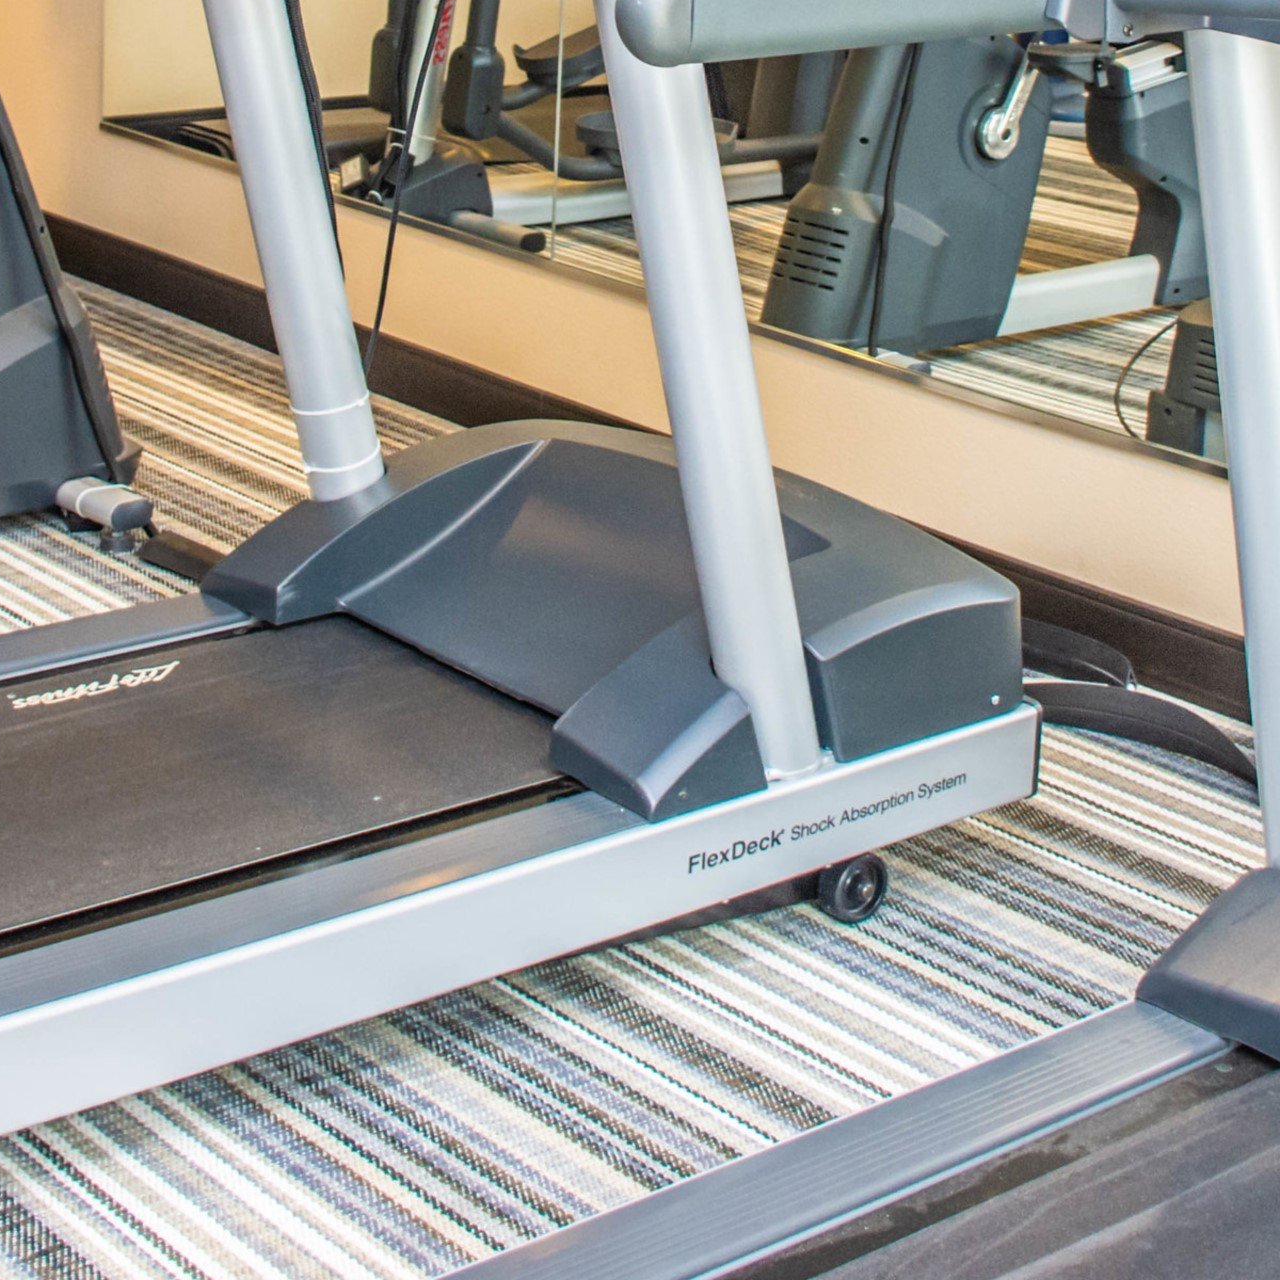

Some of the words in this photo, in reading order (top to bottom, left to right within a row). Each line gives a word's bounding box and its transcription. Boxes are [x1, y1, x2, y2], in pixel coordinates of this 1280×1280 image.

[688, 829, 782, 874] FlexDeck
[790, 815, 836, 841] Shock
[839, 789, 914, 826] Absorption
[917, 771, 967, 799] System
